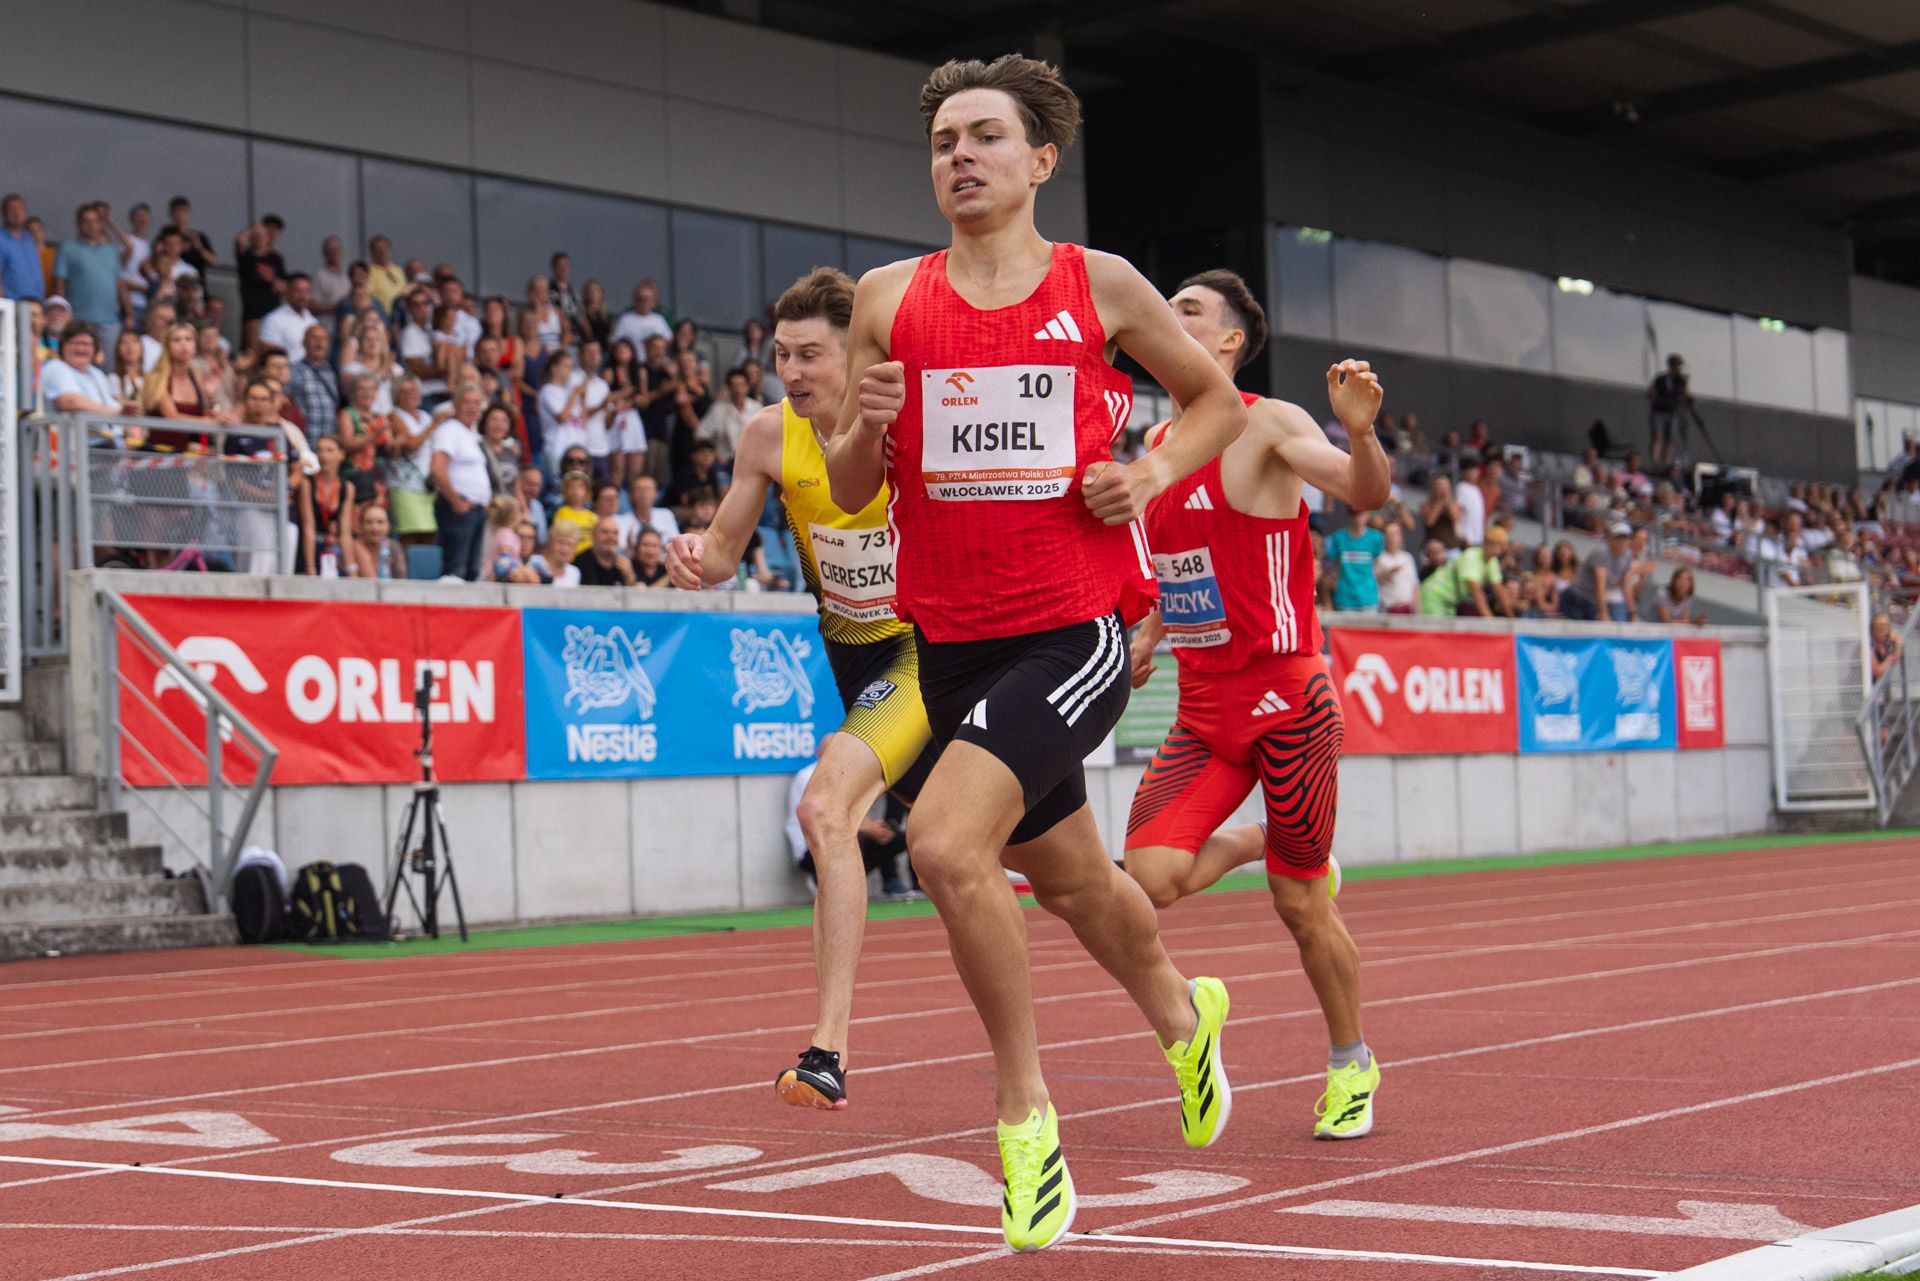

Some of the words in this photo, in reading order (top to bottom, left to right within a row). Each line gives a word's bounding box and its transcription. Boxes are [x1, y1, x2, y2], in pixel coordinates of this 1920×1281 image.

[1018, 373, 1053, 399] 10
[941, 397, 978, 406] ORLEN
[952, 422, 1045, 453] KISIEL
[936, 473, 947, 481] 79.
[969, 471, 1019, 480] Mistrzostwa
[1020, 470, 1044, 479] Polski
[1046, 469, 1062, 478] U20
[939, 485, 1023, 497] WŁOCŁAWEK
[1027, 483, 1060, 495] 2025
[812, 532, 845, 547] POLAR
[820, 560, 895, 588] CIERESZK
[1171, 555, 1204, 577] 548
[285, 654, 495, 724] ORLEN
[1404, 665, 1505, 714] ORLEN
[566, 723, 658, 763] Nestlé
[733, 722, 816, 760] Nestlé
